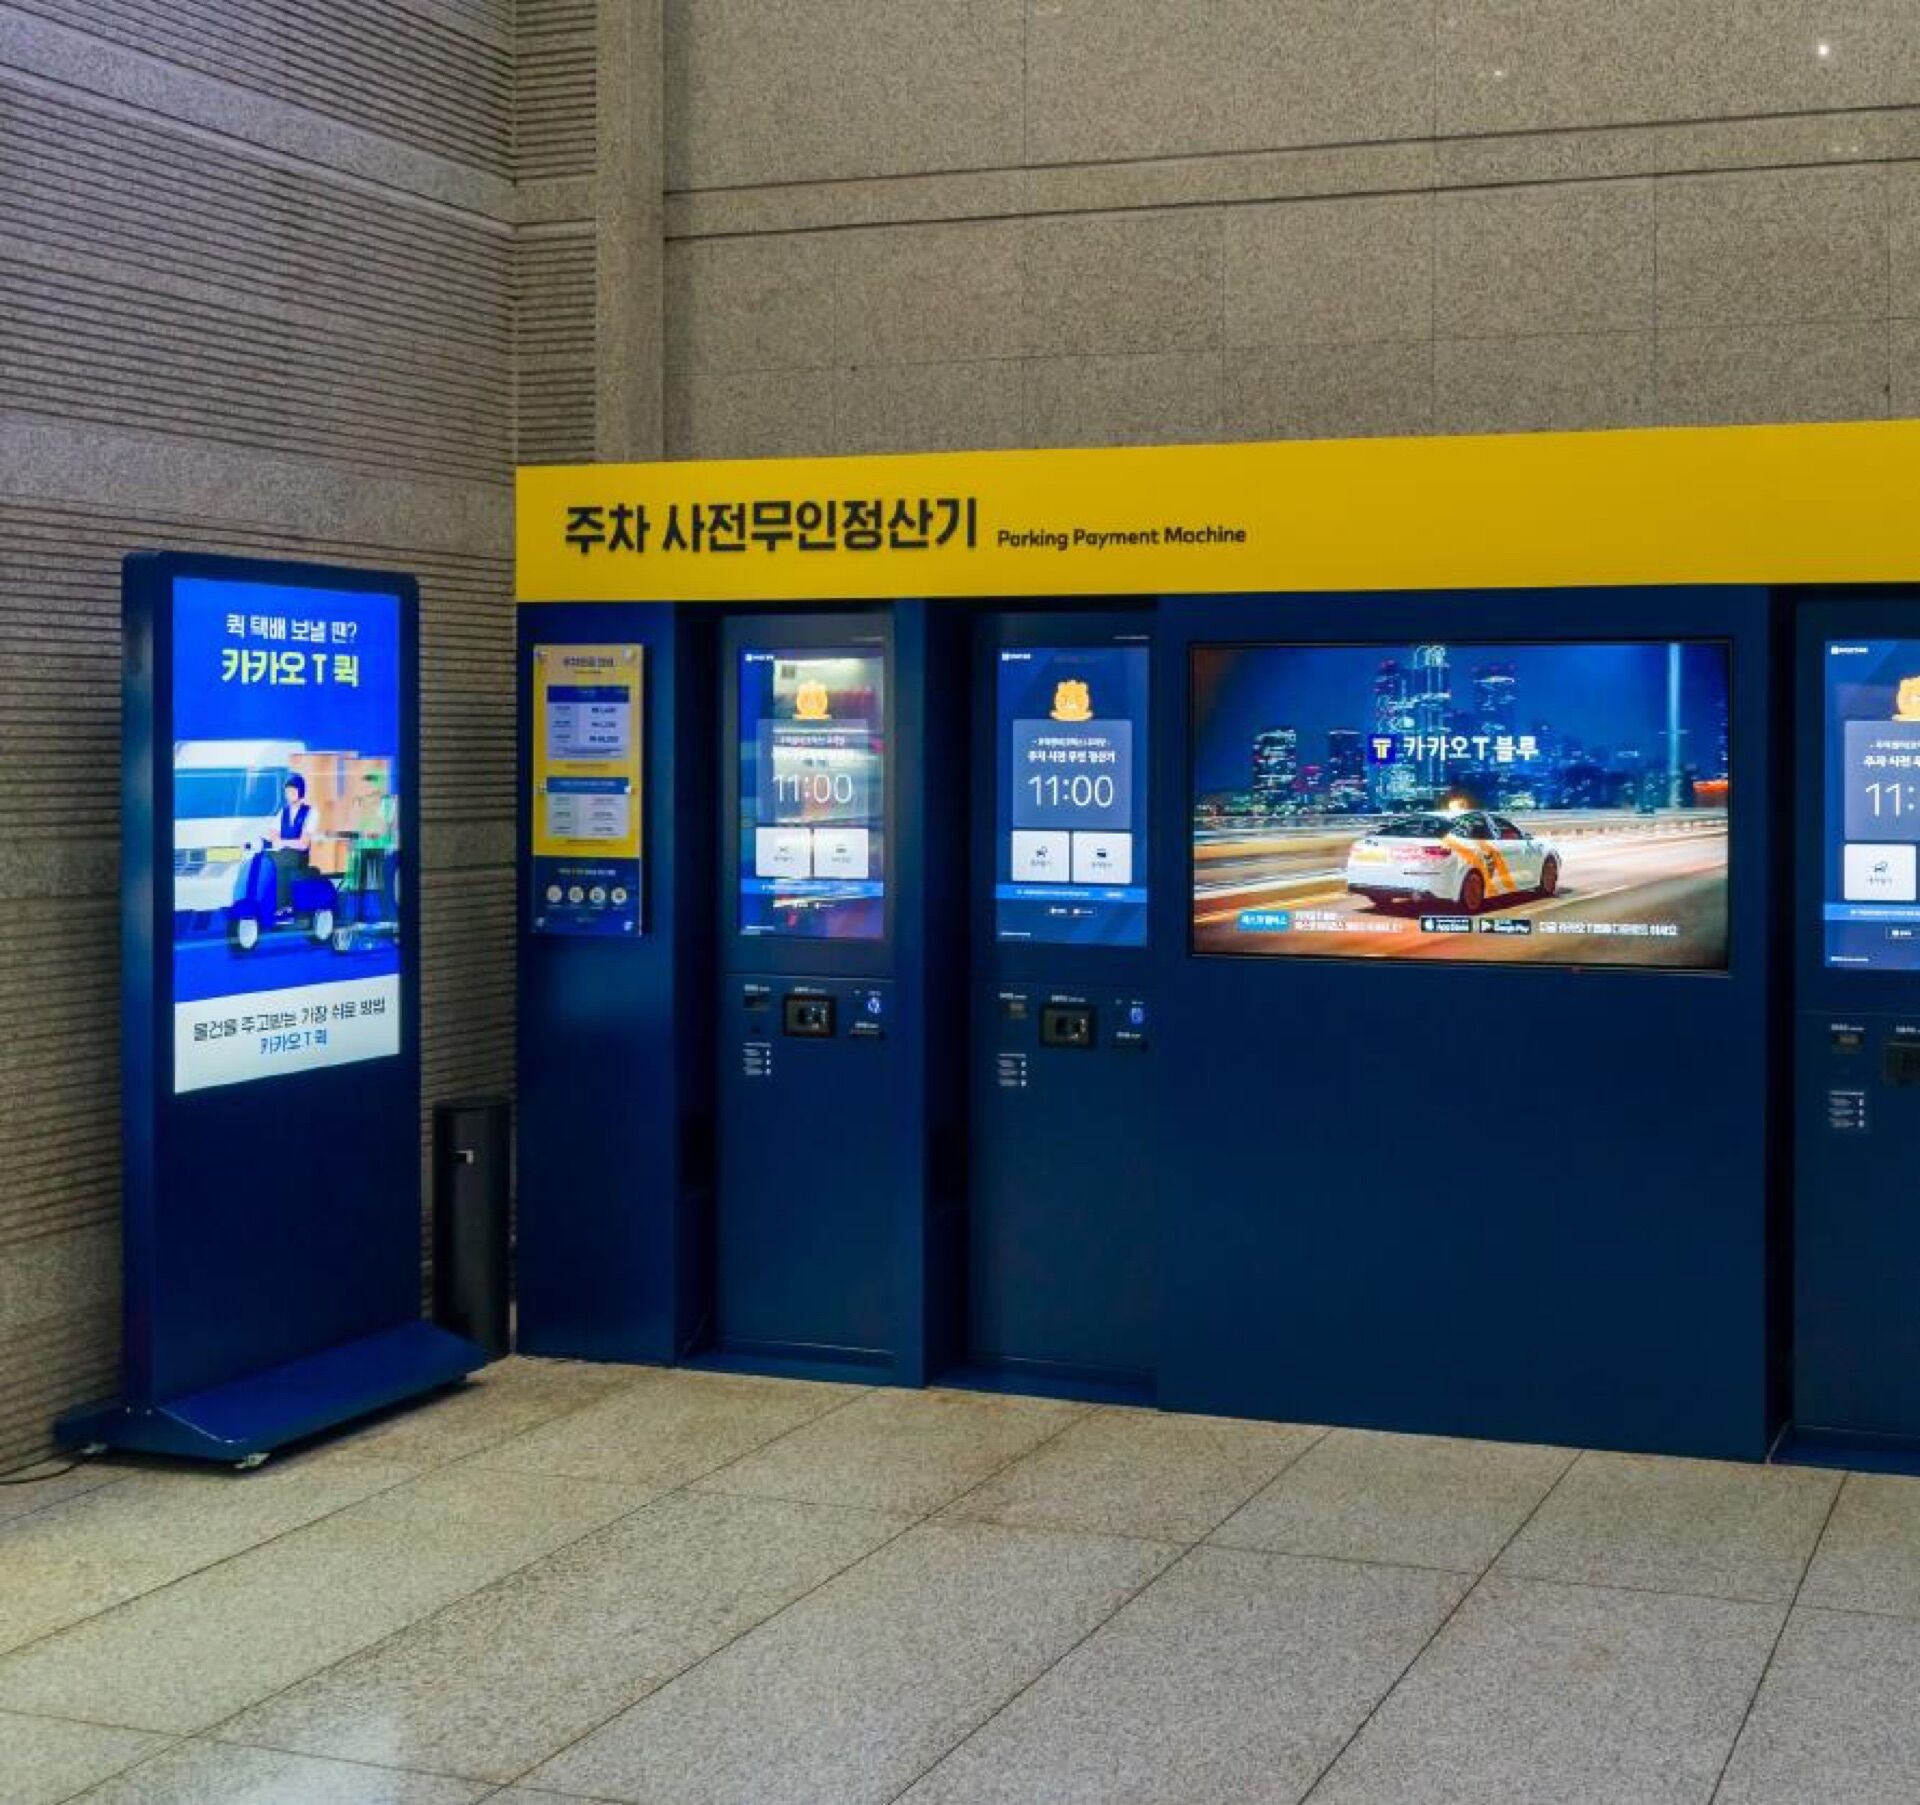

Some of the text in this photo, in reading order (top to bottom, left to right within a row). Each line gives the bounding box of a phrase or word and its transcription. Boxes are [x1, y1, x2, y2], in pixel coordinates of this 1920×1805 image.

[565, 497, 977, 554] 주차 사전무인정산기
[997, 526, 1247, 551] Parking Payment Machine
[250, 614, 286, 640] 택배
[290, 618, 326, 643] 보낼
[221, 648, 360, 688] 카카오 T 퀵
[1493, 735, 1540, 763] 블루
[772, 774, 853, 804] 11:00
[1027, 774, 1114, 807] 11:00
[260, 1032, 301, 1055] 카카오
